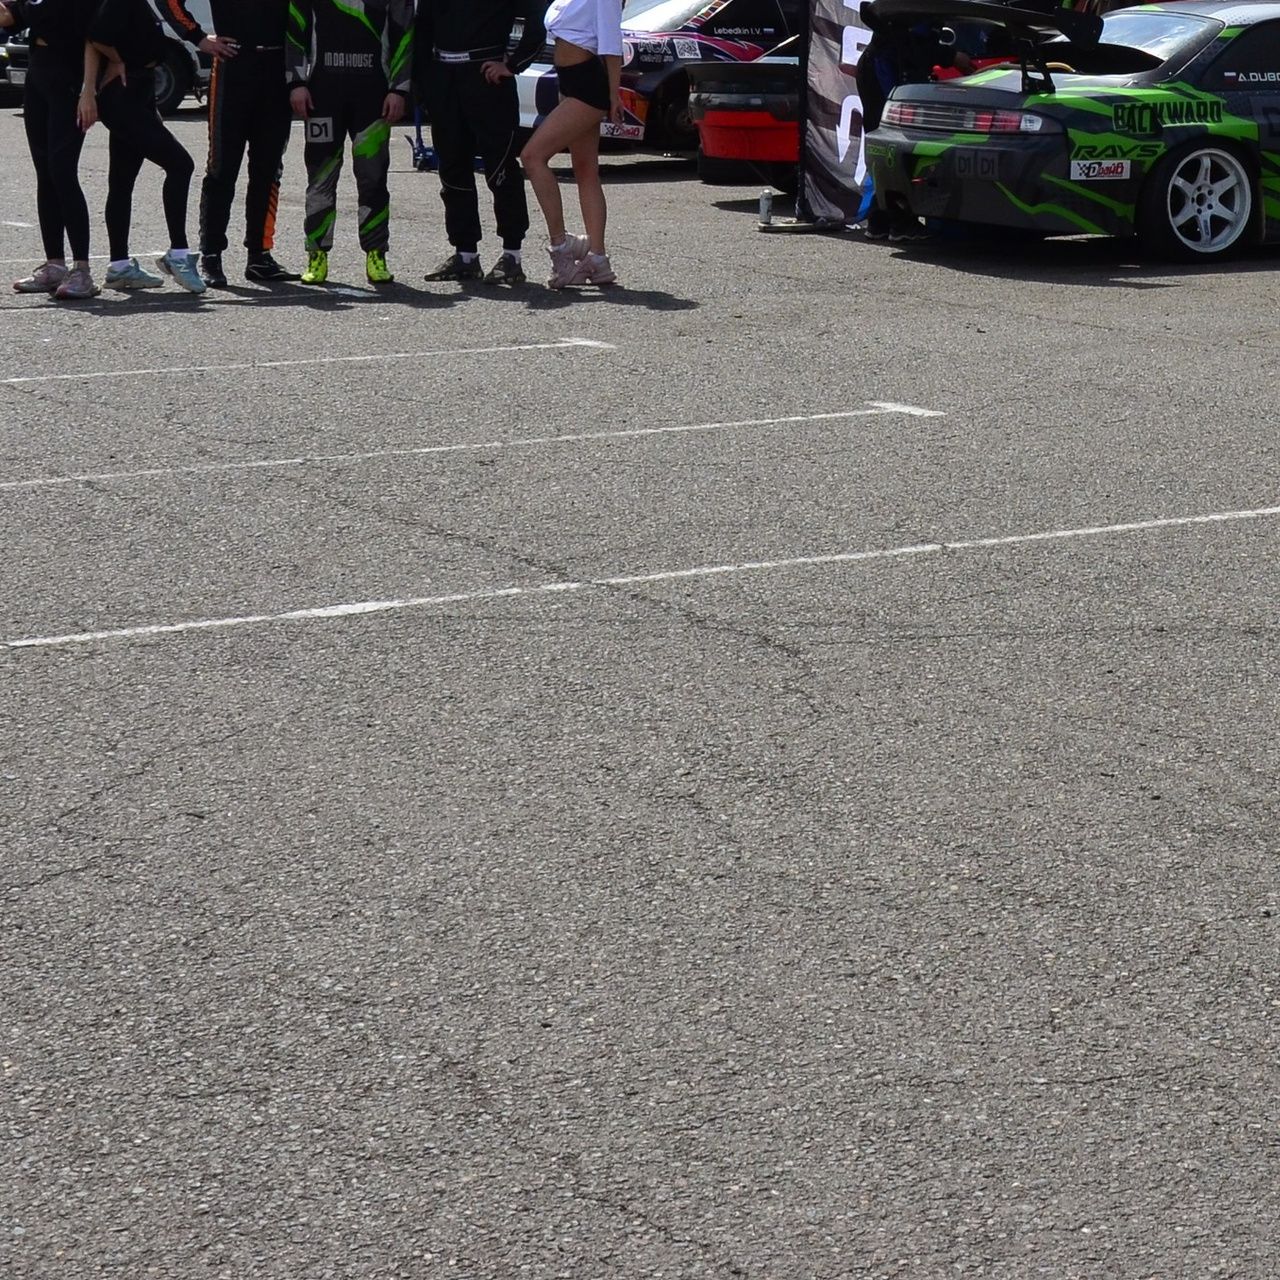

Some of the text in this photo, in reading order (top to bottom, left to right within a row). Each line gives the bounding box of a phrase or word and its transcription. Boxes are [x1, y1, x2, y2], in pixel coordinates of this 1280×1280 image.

[714, 27, 749, 35] Lebedkin
[345, 53, 373, 67] HOUSE
[1113, 100, 1222, 134] BACKWARD
[310, 123, 329, 138] D1
[1071, 144, 1162, 158] RAYS
